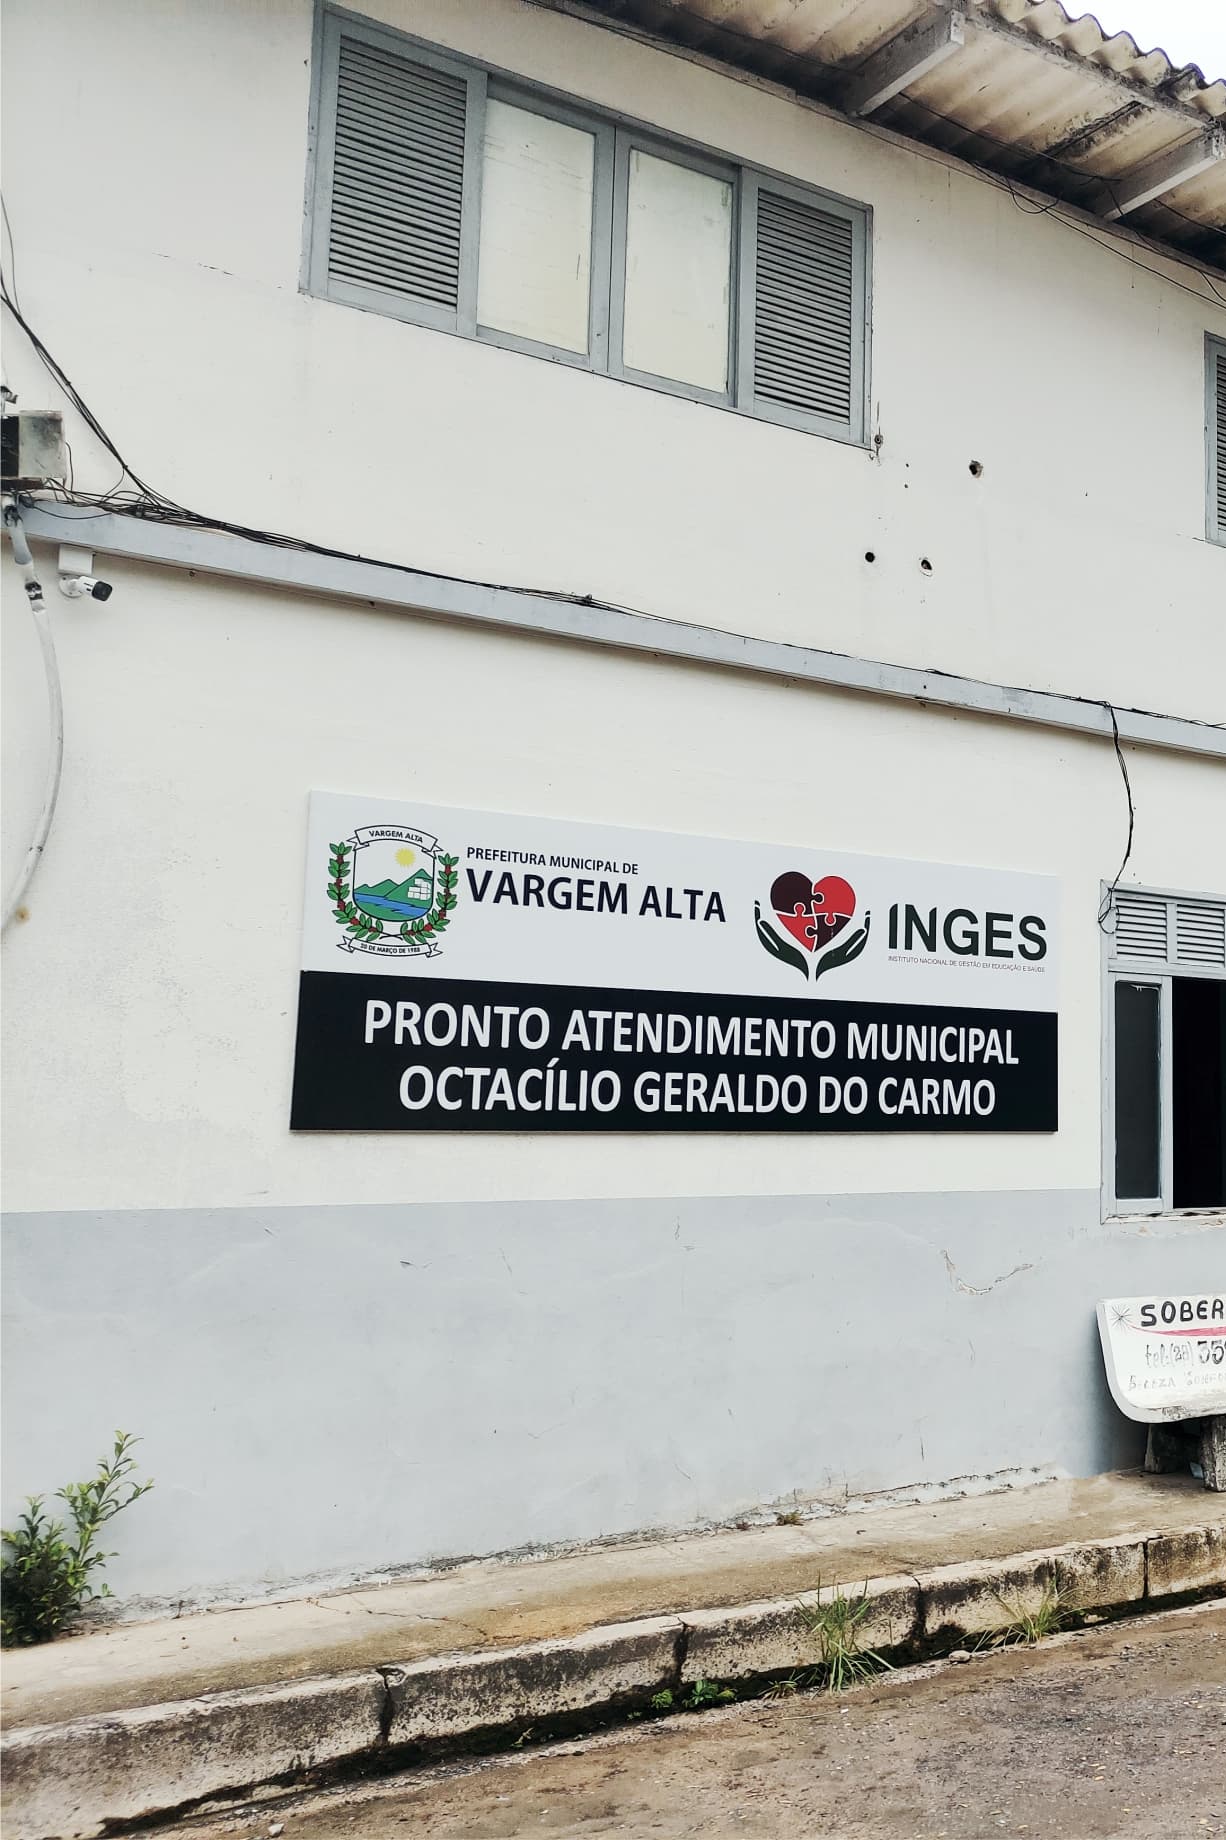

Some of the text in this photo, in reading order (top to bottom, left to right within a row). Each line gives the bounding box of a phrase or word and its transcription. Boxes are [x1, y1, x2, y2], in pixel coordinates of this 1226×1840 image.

[368, 830, 423, 843] VARGEM ALTA
[467, 847, 639, 875] PREFEITURA MUNICIPAL DE
[466, 868, 726, 923] VARGEM ALTA
[888, 903, 1047, 961] INGES
[888, 955, 919, 964] INSTITUTO
[919, 958, 948, 966] NACIONAL
[364, 1000, 1019, 1065] PRONTO ATENDIMENTO MUNICIPAL
[399, 1057, 996, 1116] OCTACÍLIO GERALDO DO CARMO
